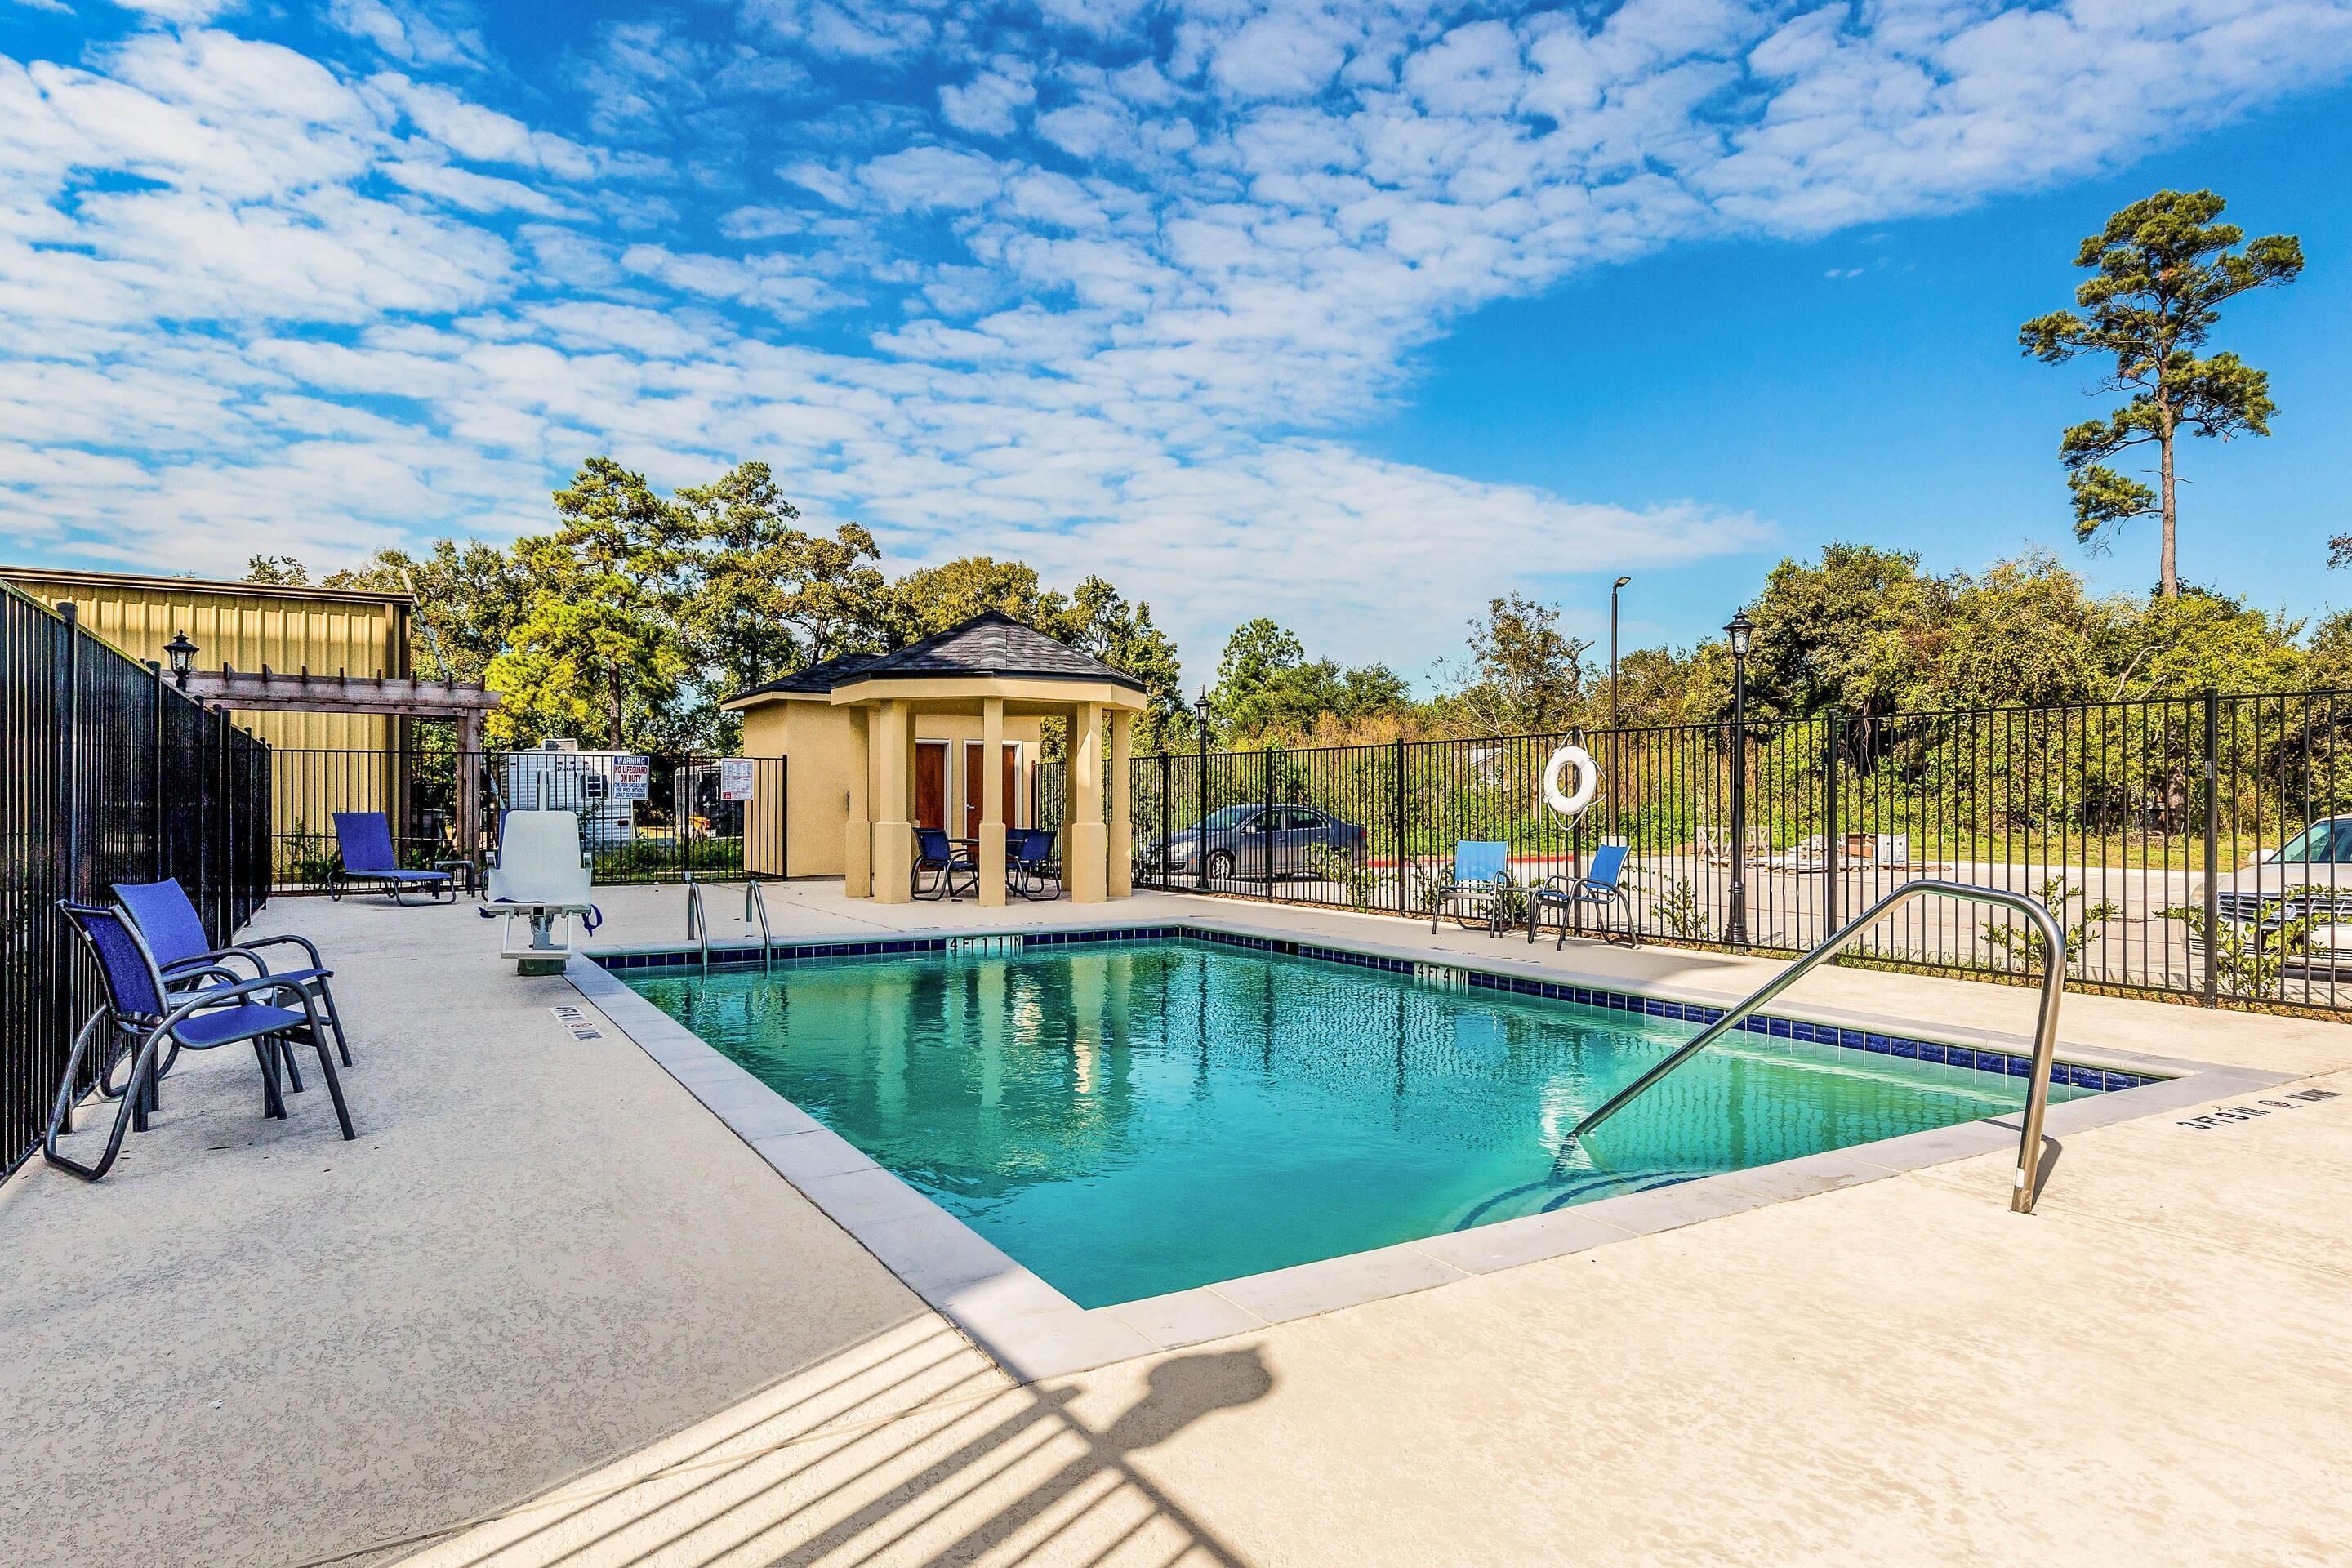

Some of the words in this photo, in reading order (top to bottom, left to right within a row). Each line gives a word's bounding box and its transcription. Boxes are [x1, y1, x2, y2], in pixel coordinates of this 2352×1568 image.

[617, 756, 645, 765] WARNING
[614, 765, 621, 774] NO
[623, 766, 648, 774] LIFEGUARD
[621, 774, 627, 782] ON
[628, 774, 641, 782] DUTY
[950, 938, 958, 950] 4
[963, 937, 976, 950] FT
[1009, 935, 1021, 948] IN
[1418, 963, 1424, 978] 4
[1428, 964, 1439, 979] FT
[1443, 967, 1450, 981] 4
[1455, 969, 1466, 983] IN
[2215, 1112, 2250, 1120] 9
[2176, 1121, 2212, 1129] 3
[2190, 1116, 2234, 1126] FT
